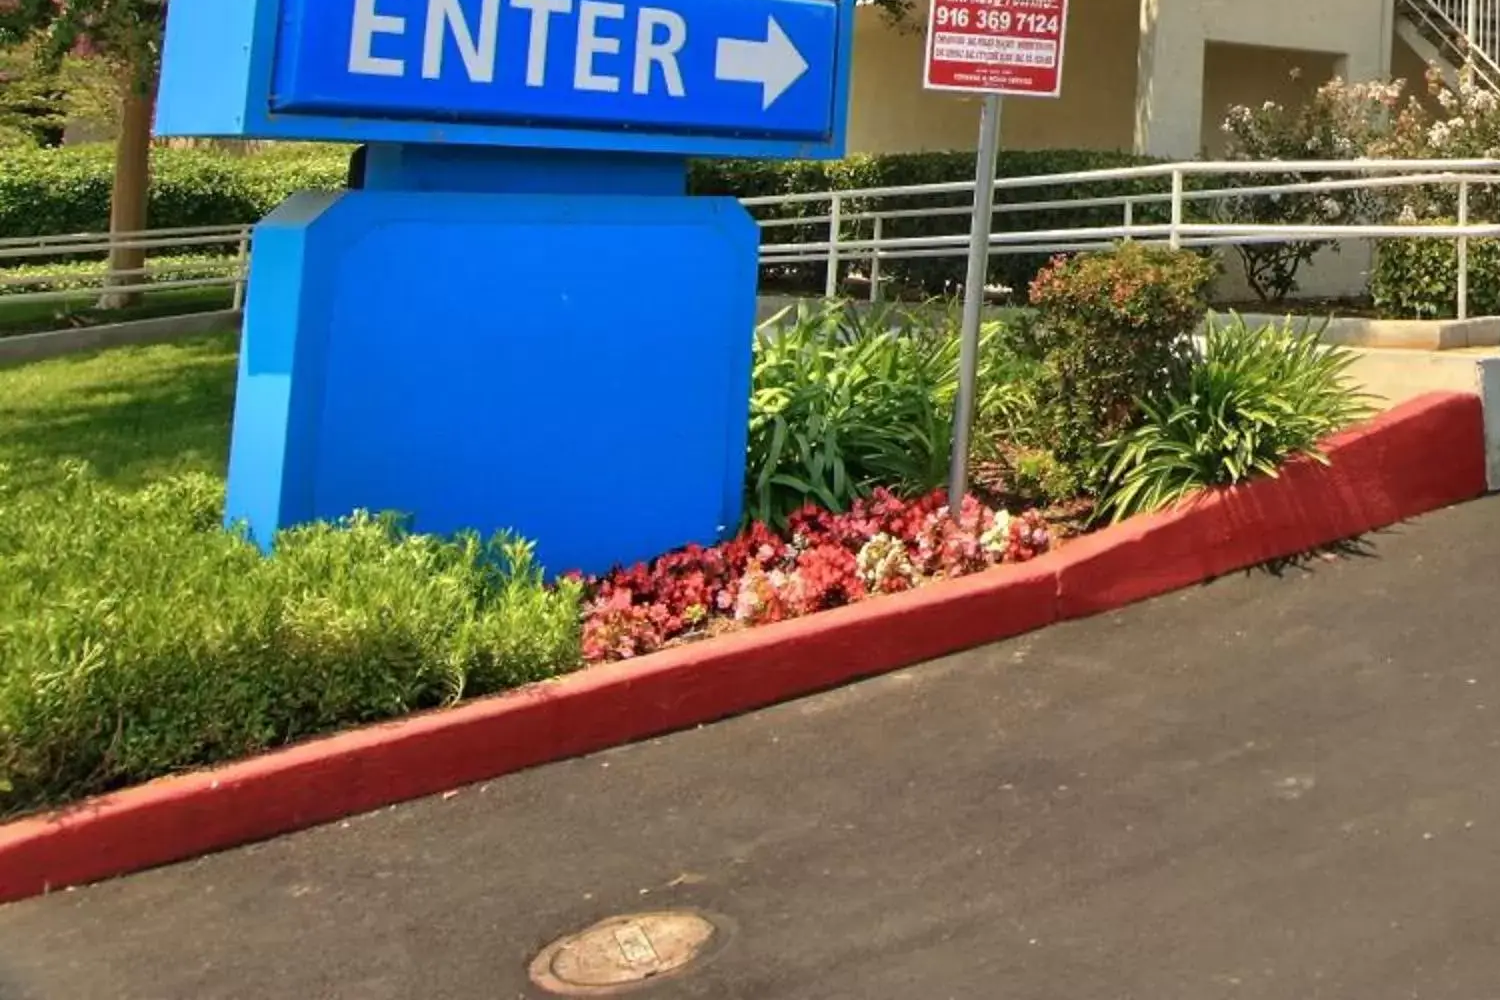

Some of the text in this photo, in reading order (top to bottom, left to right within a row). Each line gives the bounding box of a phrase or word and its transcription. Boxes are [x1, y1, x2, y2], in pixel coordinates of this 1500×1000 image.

[936, 6, 1058, 33] 916 369 7124
